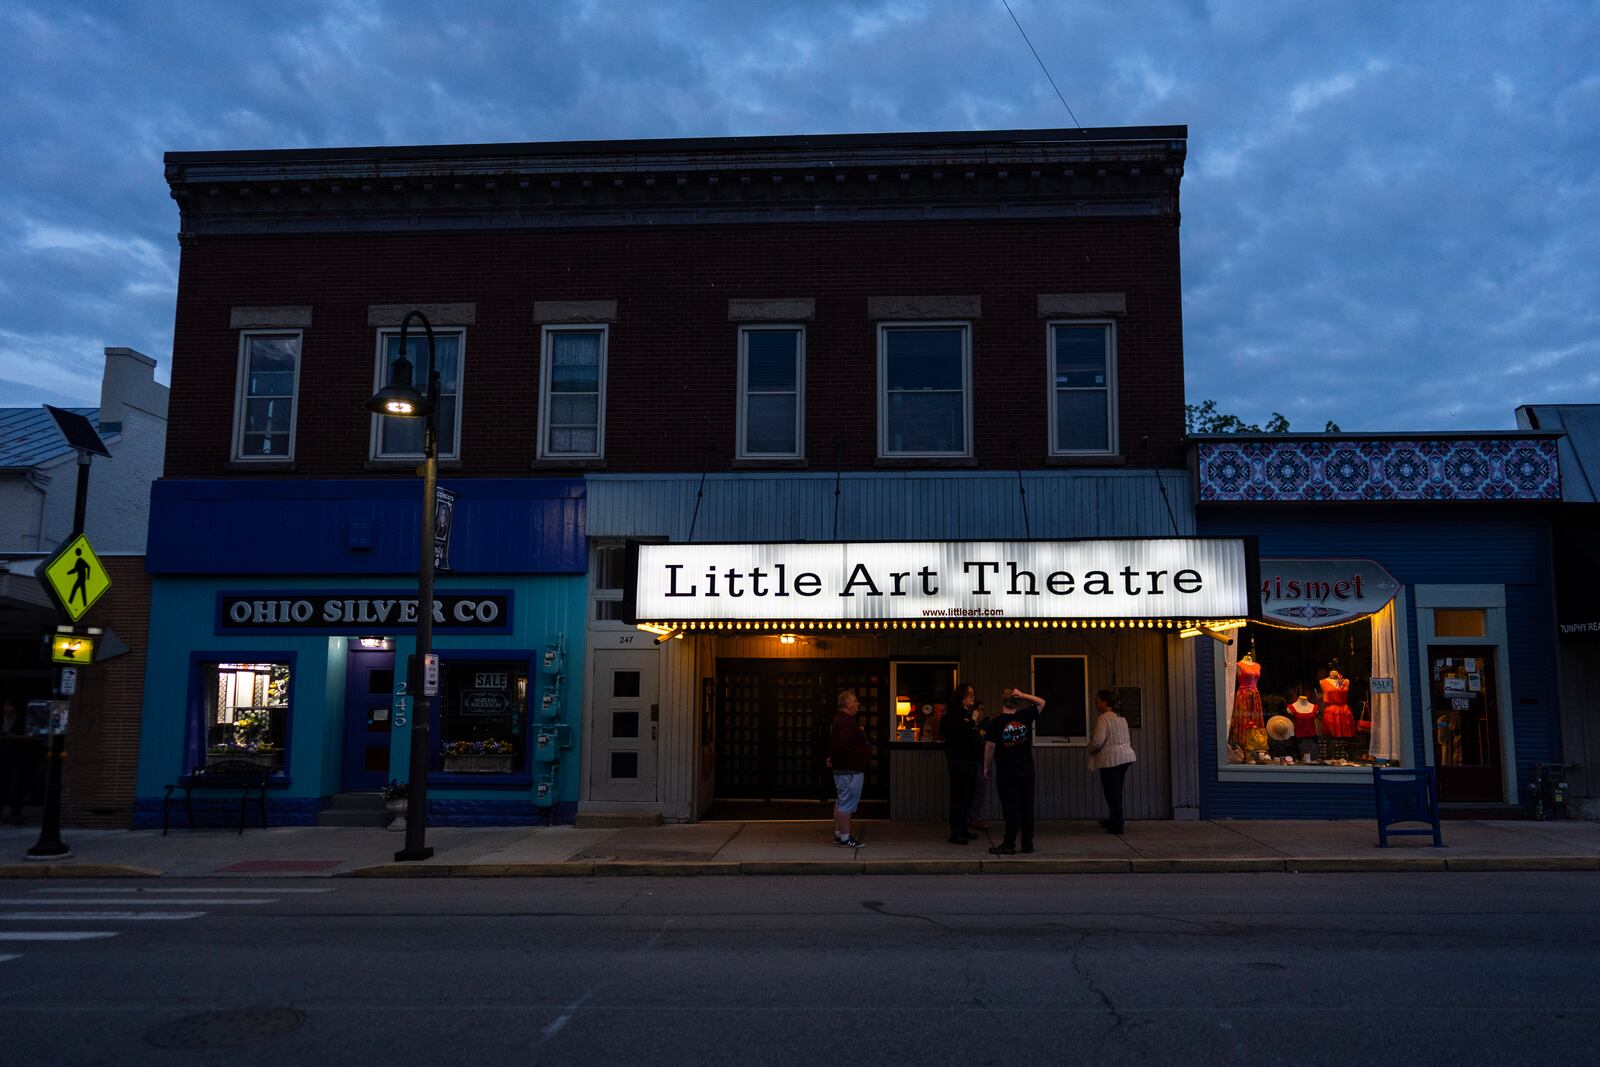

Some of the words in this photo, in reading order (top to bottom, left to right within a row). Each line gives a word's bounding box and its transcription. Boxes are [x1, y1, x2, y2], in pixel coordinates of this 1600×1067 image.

[664, 563, 822, 598] Little
[838, 563, 939, 597] Art
[963, 561, 1203, 596] Theatre
[229, 599, 315, 624] OHIO
[453, 599, 499, 624] CO
[922, 607, 1004, 616] www.littleart.com
[619, 636, 634, 644] 247
[476, 674, 506, 687] SALE
[1371, 680, 1393, 688] SALE
